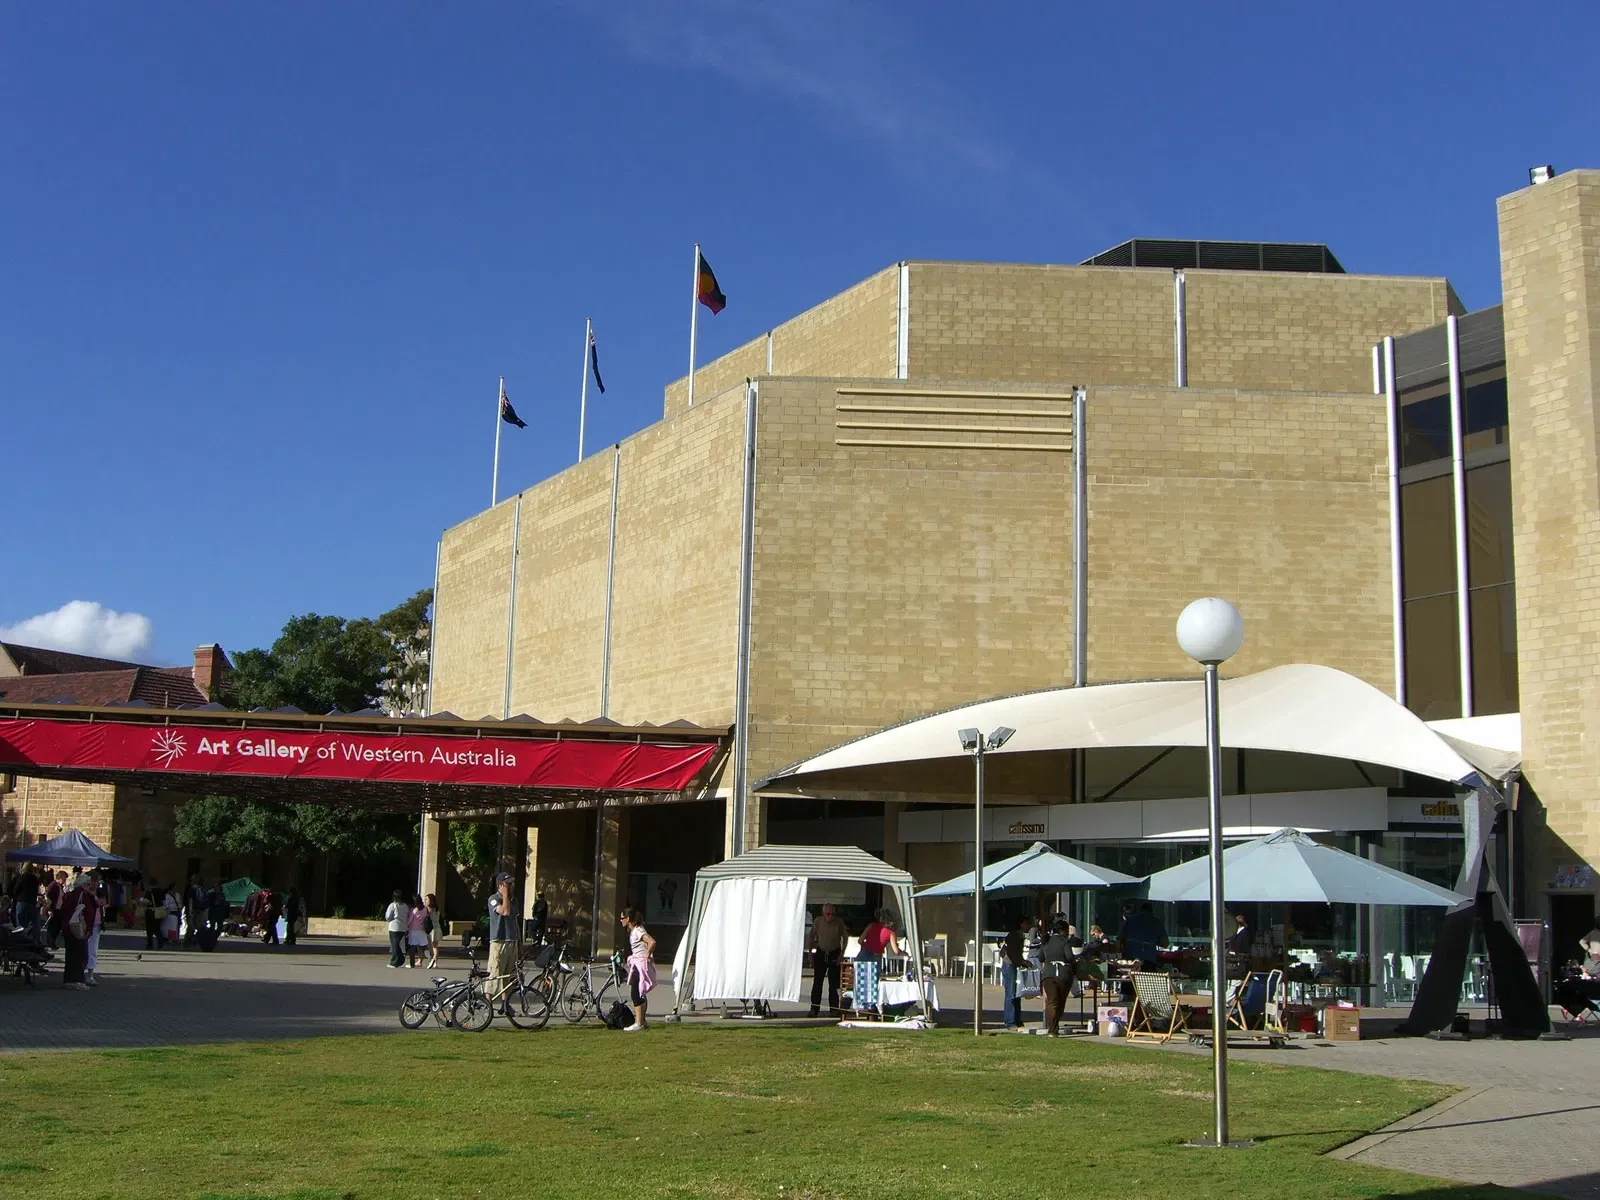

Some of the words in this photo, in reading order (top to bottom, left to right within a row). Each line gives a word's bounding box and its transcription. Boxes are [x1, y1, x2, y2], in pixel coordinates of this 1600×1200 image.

[197, 737, 230, 755] Art
[236, 738, 310, 763] Gallery
[316, 742, 337, 760] of
[341, 743, 425, 764] Western
[430, 746, 517, 767] Australia
